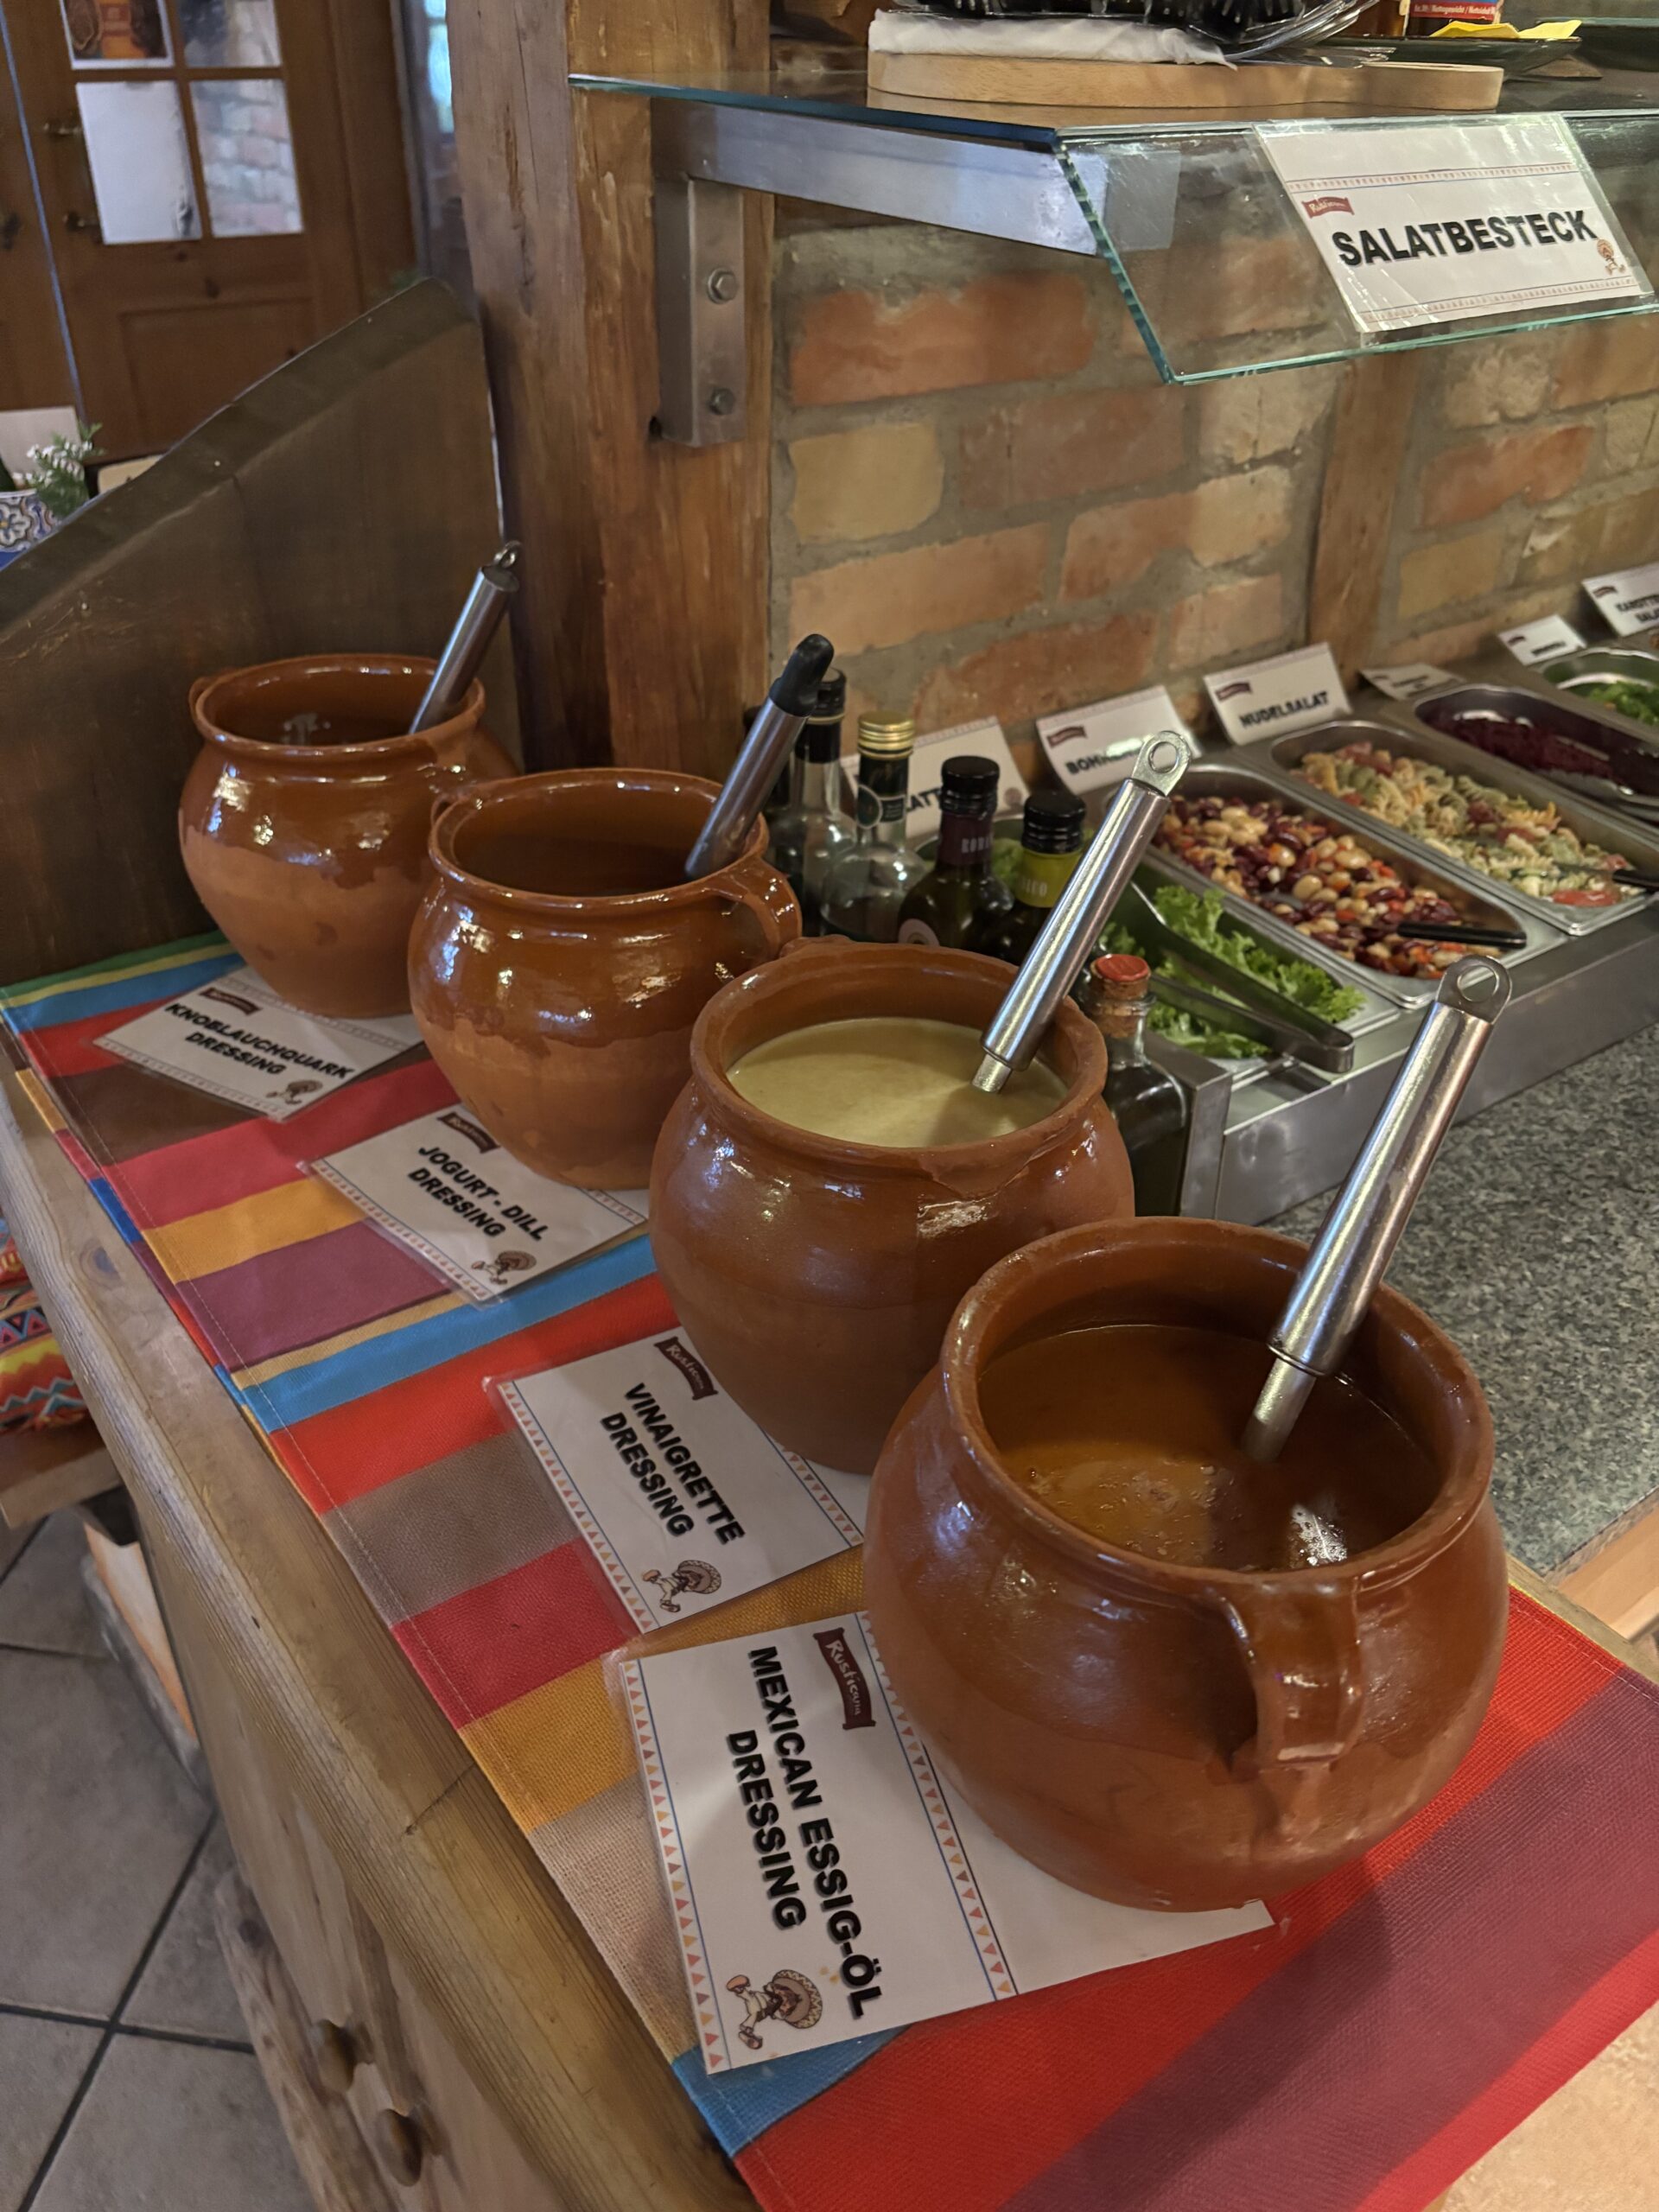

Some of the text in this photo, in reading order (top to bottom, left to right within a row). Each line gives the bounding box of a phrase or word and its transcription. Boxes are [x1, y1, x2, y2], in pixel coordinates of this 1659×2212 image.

[1332, 211, 1598, 266] SALATBESTECK
[1239, 691, 1330, 728] NUDELSALAT
[164, 1002, 355, 1079] KNOBLAUCHQUARK
[186, 1032, 287, 1075] DRESSING
[407, 1167, 506, 1238] DRESSING
[418, 1147, 499, 1199] JOGURT
[501, 1205, 550, 1240] DILL
[600, 1413, 695, 1538] DRESSING
[625, 1382, 745, 1546] VINAIGRETTE
[727, 1729, 807, 1930] DRESSING
[748, 1646, 883, 2020] MEXICAN ESSIG-ÖL
